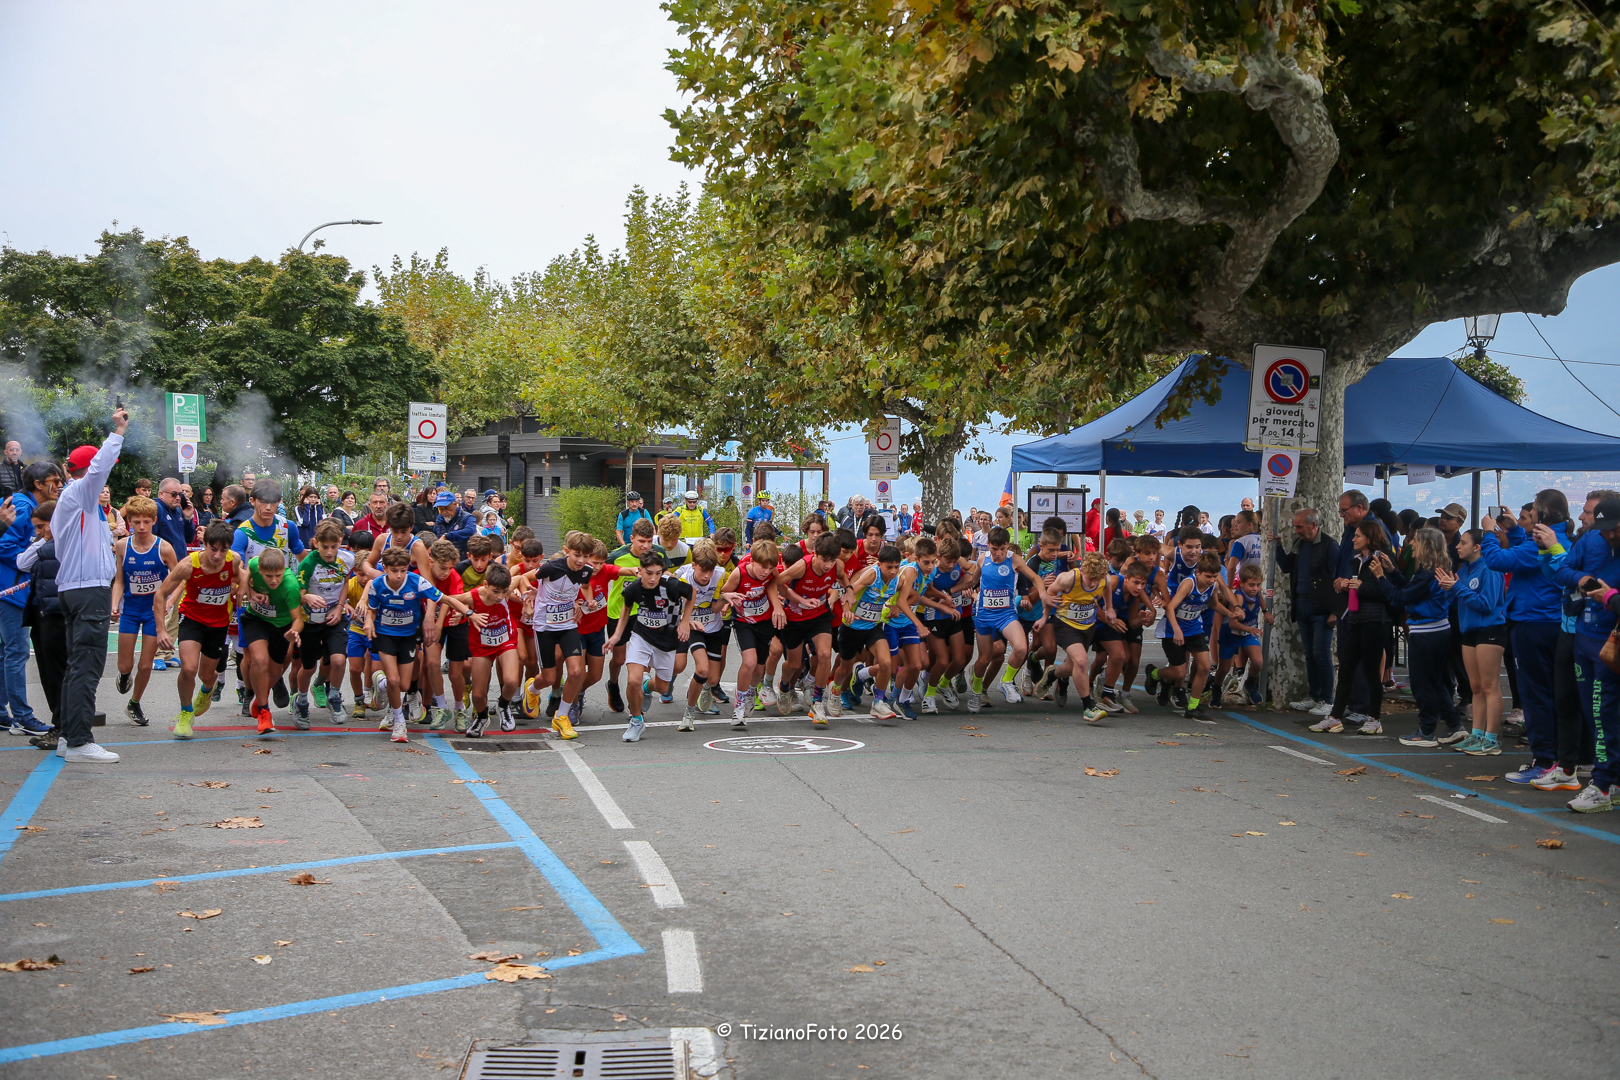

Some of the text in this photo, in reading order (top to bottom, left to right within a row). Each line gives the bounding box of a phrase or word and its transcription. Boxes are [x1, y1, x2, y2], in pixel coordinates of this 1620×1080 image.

[174, 395, 186, 414] P
[1265, 406, 1304, 417] giovedi
[1252, 416, 1315, 428] per mercato
[136, 584, 155, 593] 259
[205, 595, 225, 604] 247
[987, 598, 1004, 607] 365
[253, 603, 269, 616] 382
[753, 607, 764, 615] 75
[552, 612, 569, 622] 351
[861, 610, 877, 620] 221
[1073, 611, 1089, 619] 158
[643, 617, 661, 627] 388
[486, 635, 504, 645] 310
